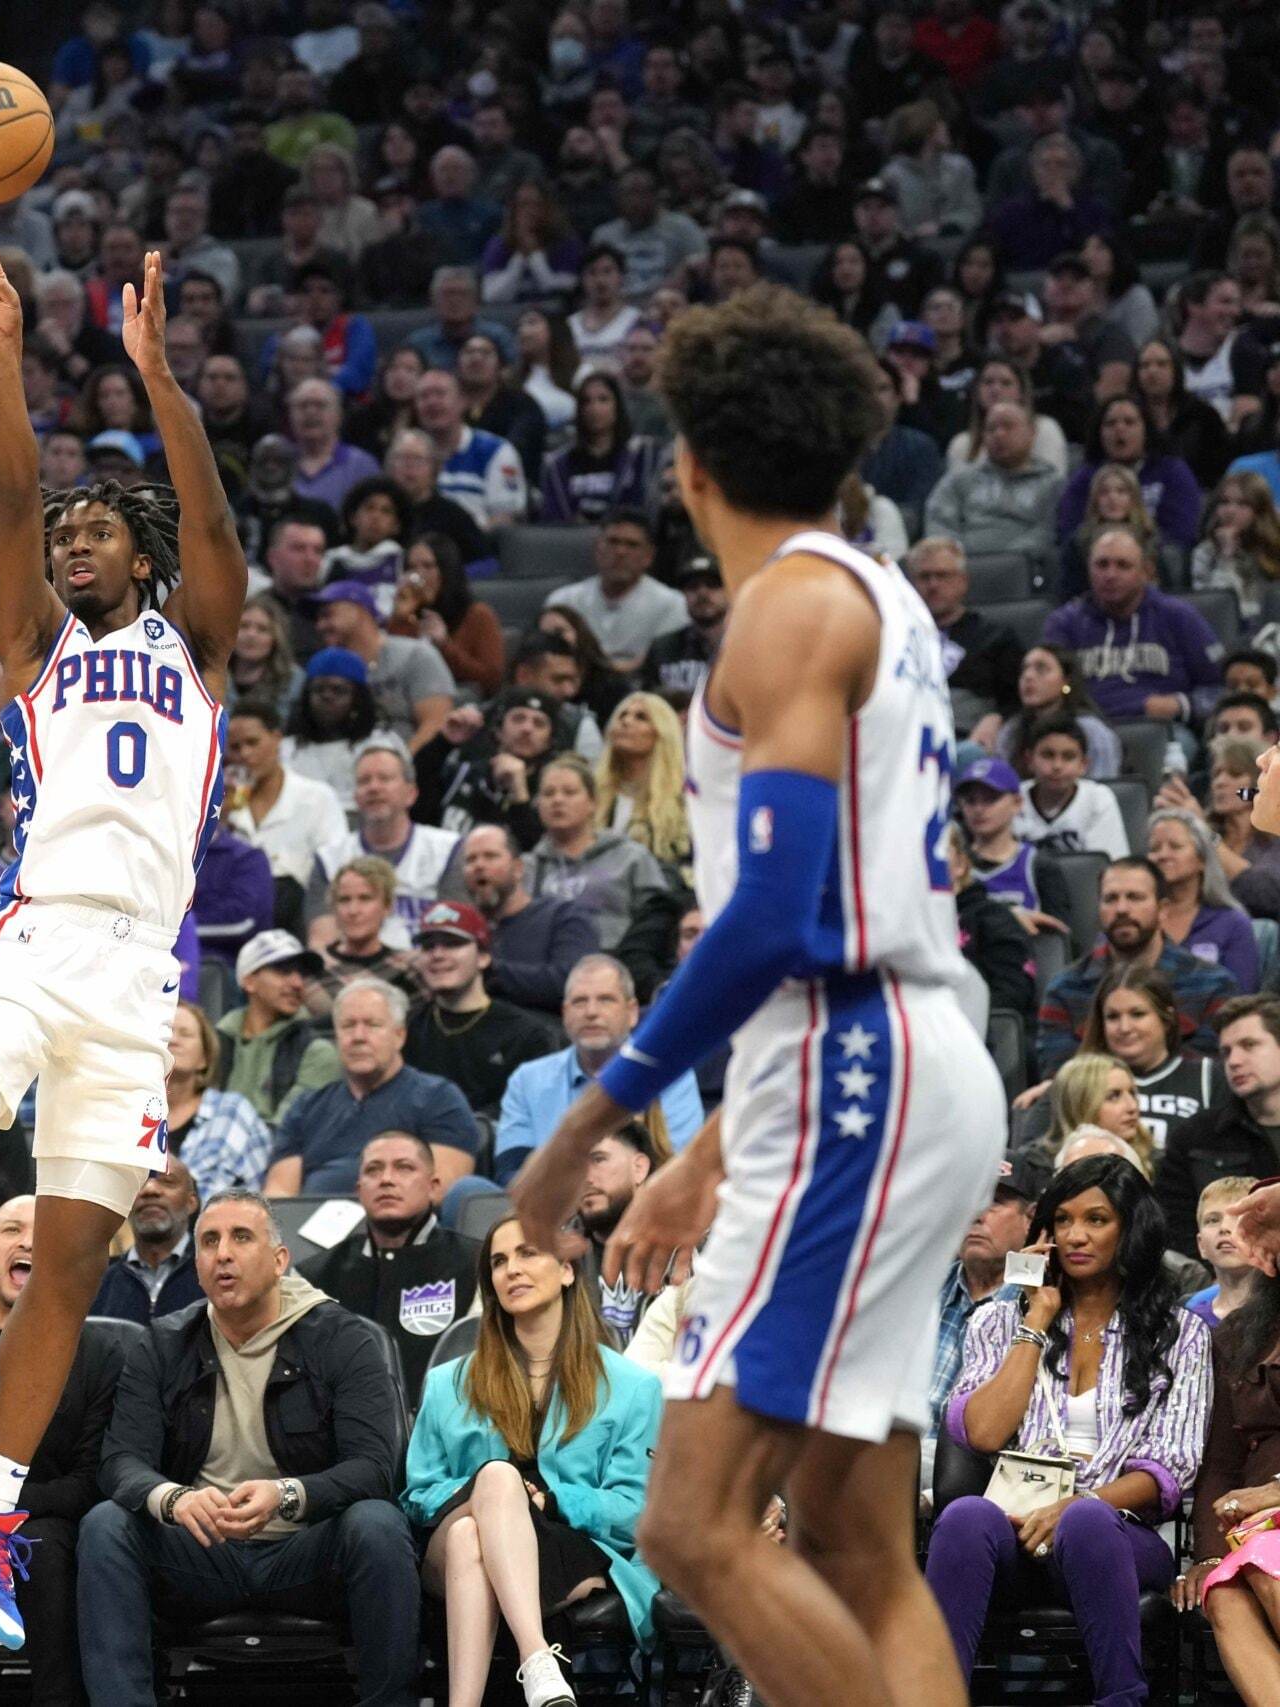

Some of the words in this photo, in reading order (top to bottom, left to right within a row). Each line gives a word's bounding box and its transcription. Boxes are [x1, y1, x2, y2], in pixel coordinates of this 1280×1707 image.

[52, 650, 183, 725] PHILA
[107, 721, 147, 788] 0
[402, 1302, 452, 1316] KINGS
